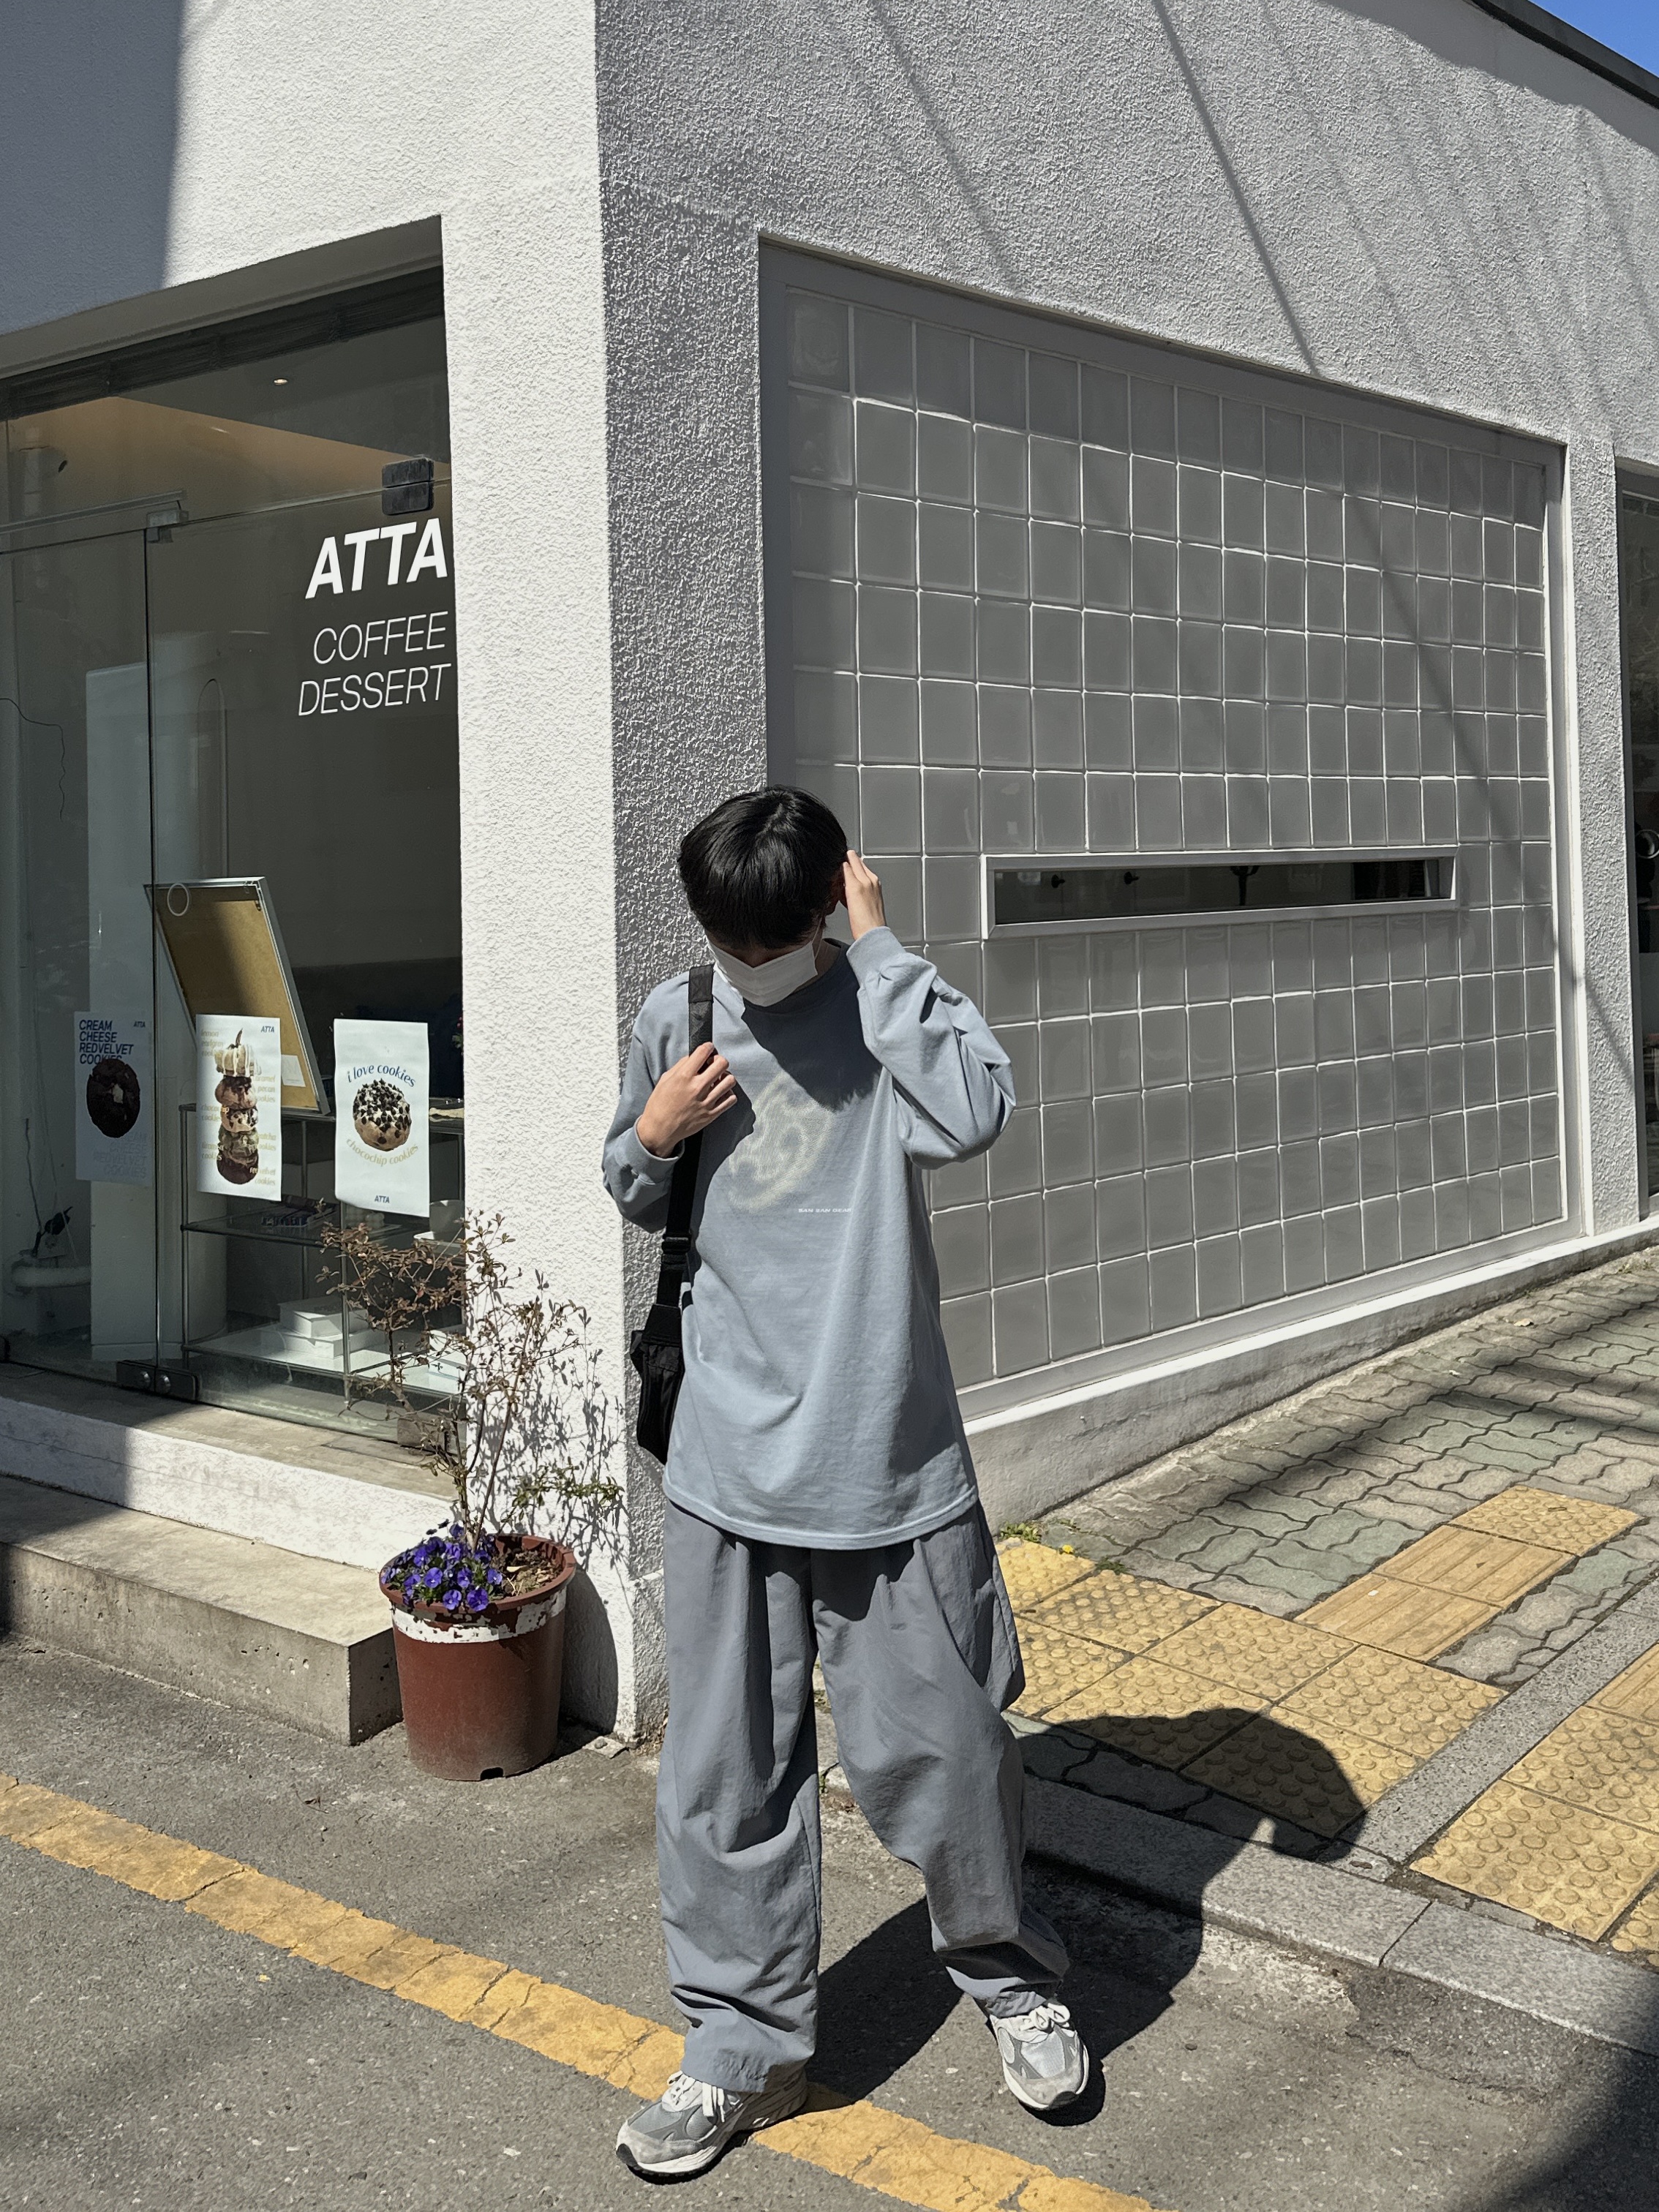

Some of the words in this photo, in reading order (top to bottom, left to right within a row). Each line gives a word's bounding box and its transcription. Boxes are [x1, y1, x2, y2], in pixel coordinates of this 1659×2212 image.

[305, 517, 448, 599] ATTA
[314, 611, 448, 664] COFFEE
[298, 663, 451, 716] DESSERT
[79, 1020, 113, 1031] CREAM
[79, 1031, 117, 1042] CHEESE
[79, 1042, 134, 1055] REDVELVET
[347, 1071, 352, 1083] i
[353, 1064, 375, 1078] love
[377, 1064, 416, 1088] cookies
[346, 1138, 387, 1167] chocochip
[389, 1144, 418, 1165] cookies
[375, 1195, 390, 1203] ATTA
